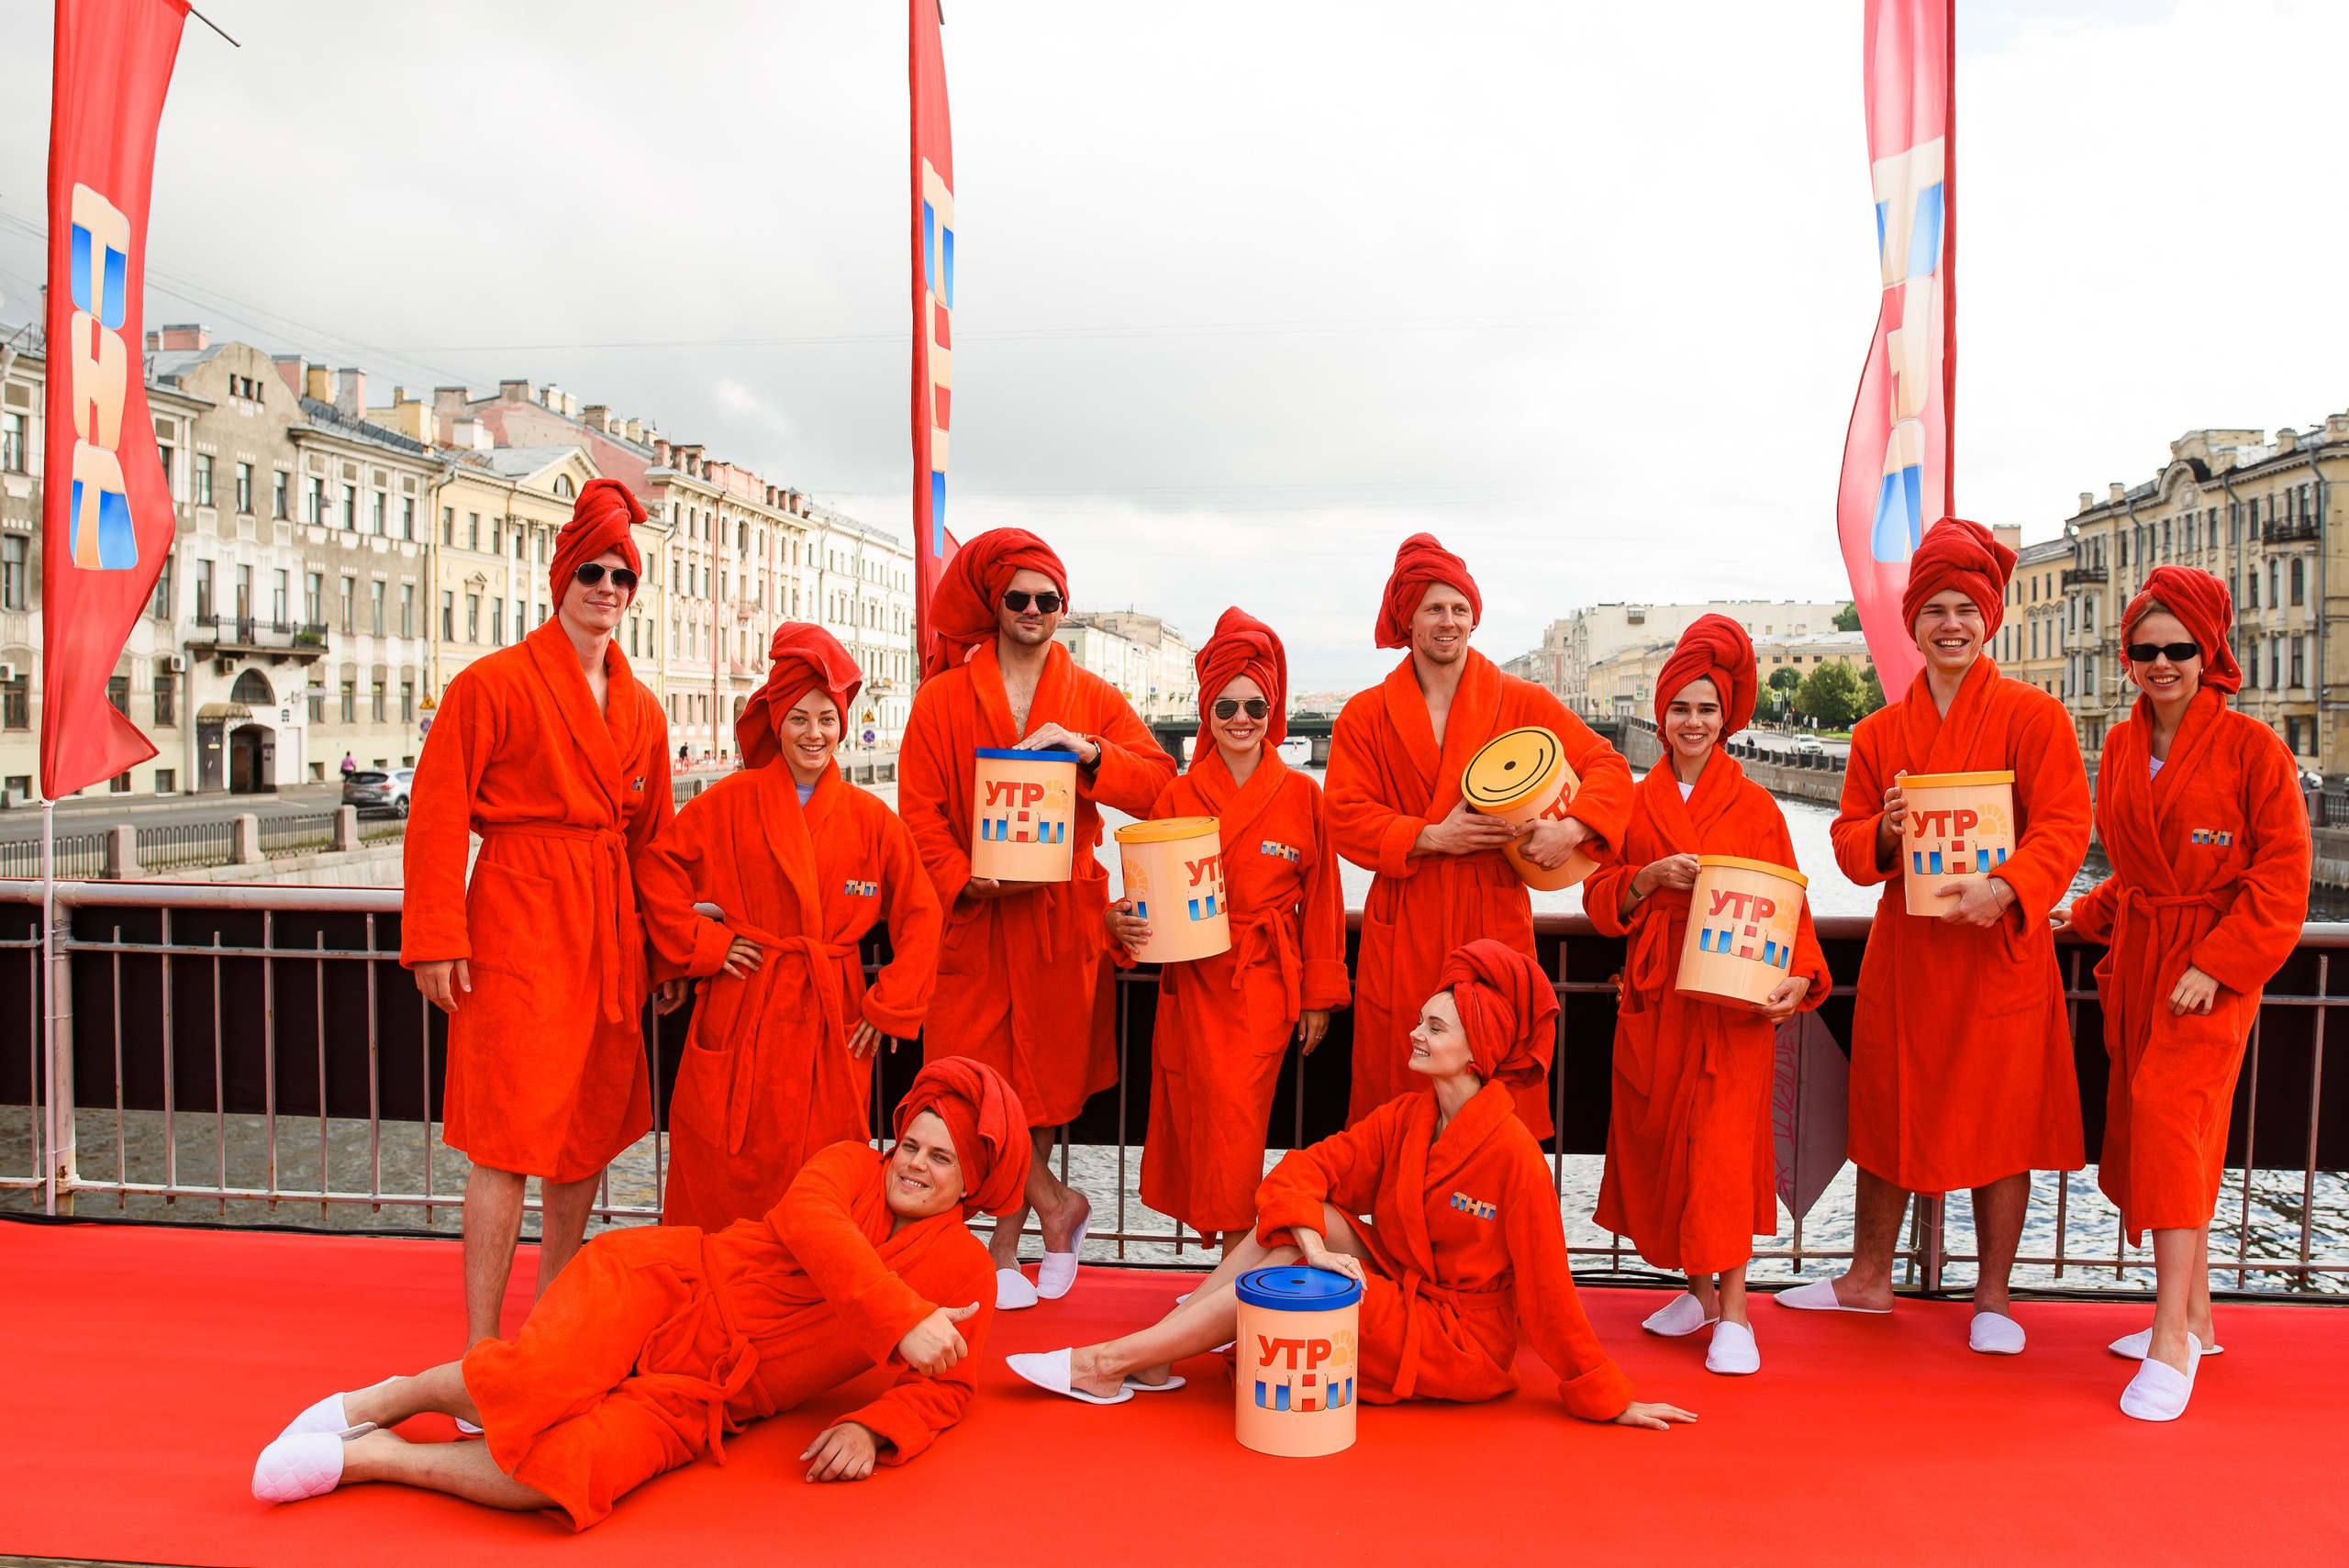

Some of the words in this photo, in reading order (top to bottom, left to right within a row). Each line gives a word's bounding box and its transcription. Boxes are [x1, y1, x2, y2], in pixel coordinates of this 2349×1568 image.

[71, 183, 139, 570] ТНТ
[982, 809, 1064, 843] ТНТ
[2192, 828, 2233, 847] ТНТ
[1262, 840, 1299, 862] ТНТ
[1913, 837, 2007, 874] ТНТ
[844, 879, 878, 897] ТНТ
[1699, 918, 1790, 970] ТНТ
[1450, 1191, 1497, 1221] ТНТ
[1255, 1365, 1353, 1413] ТНТ
